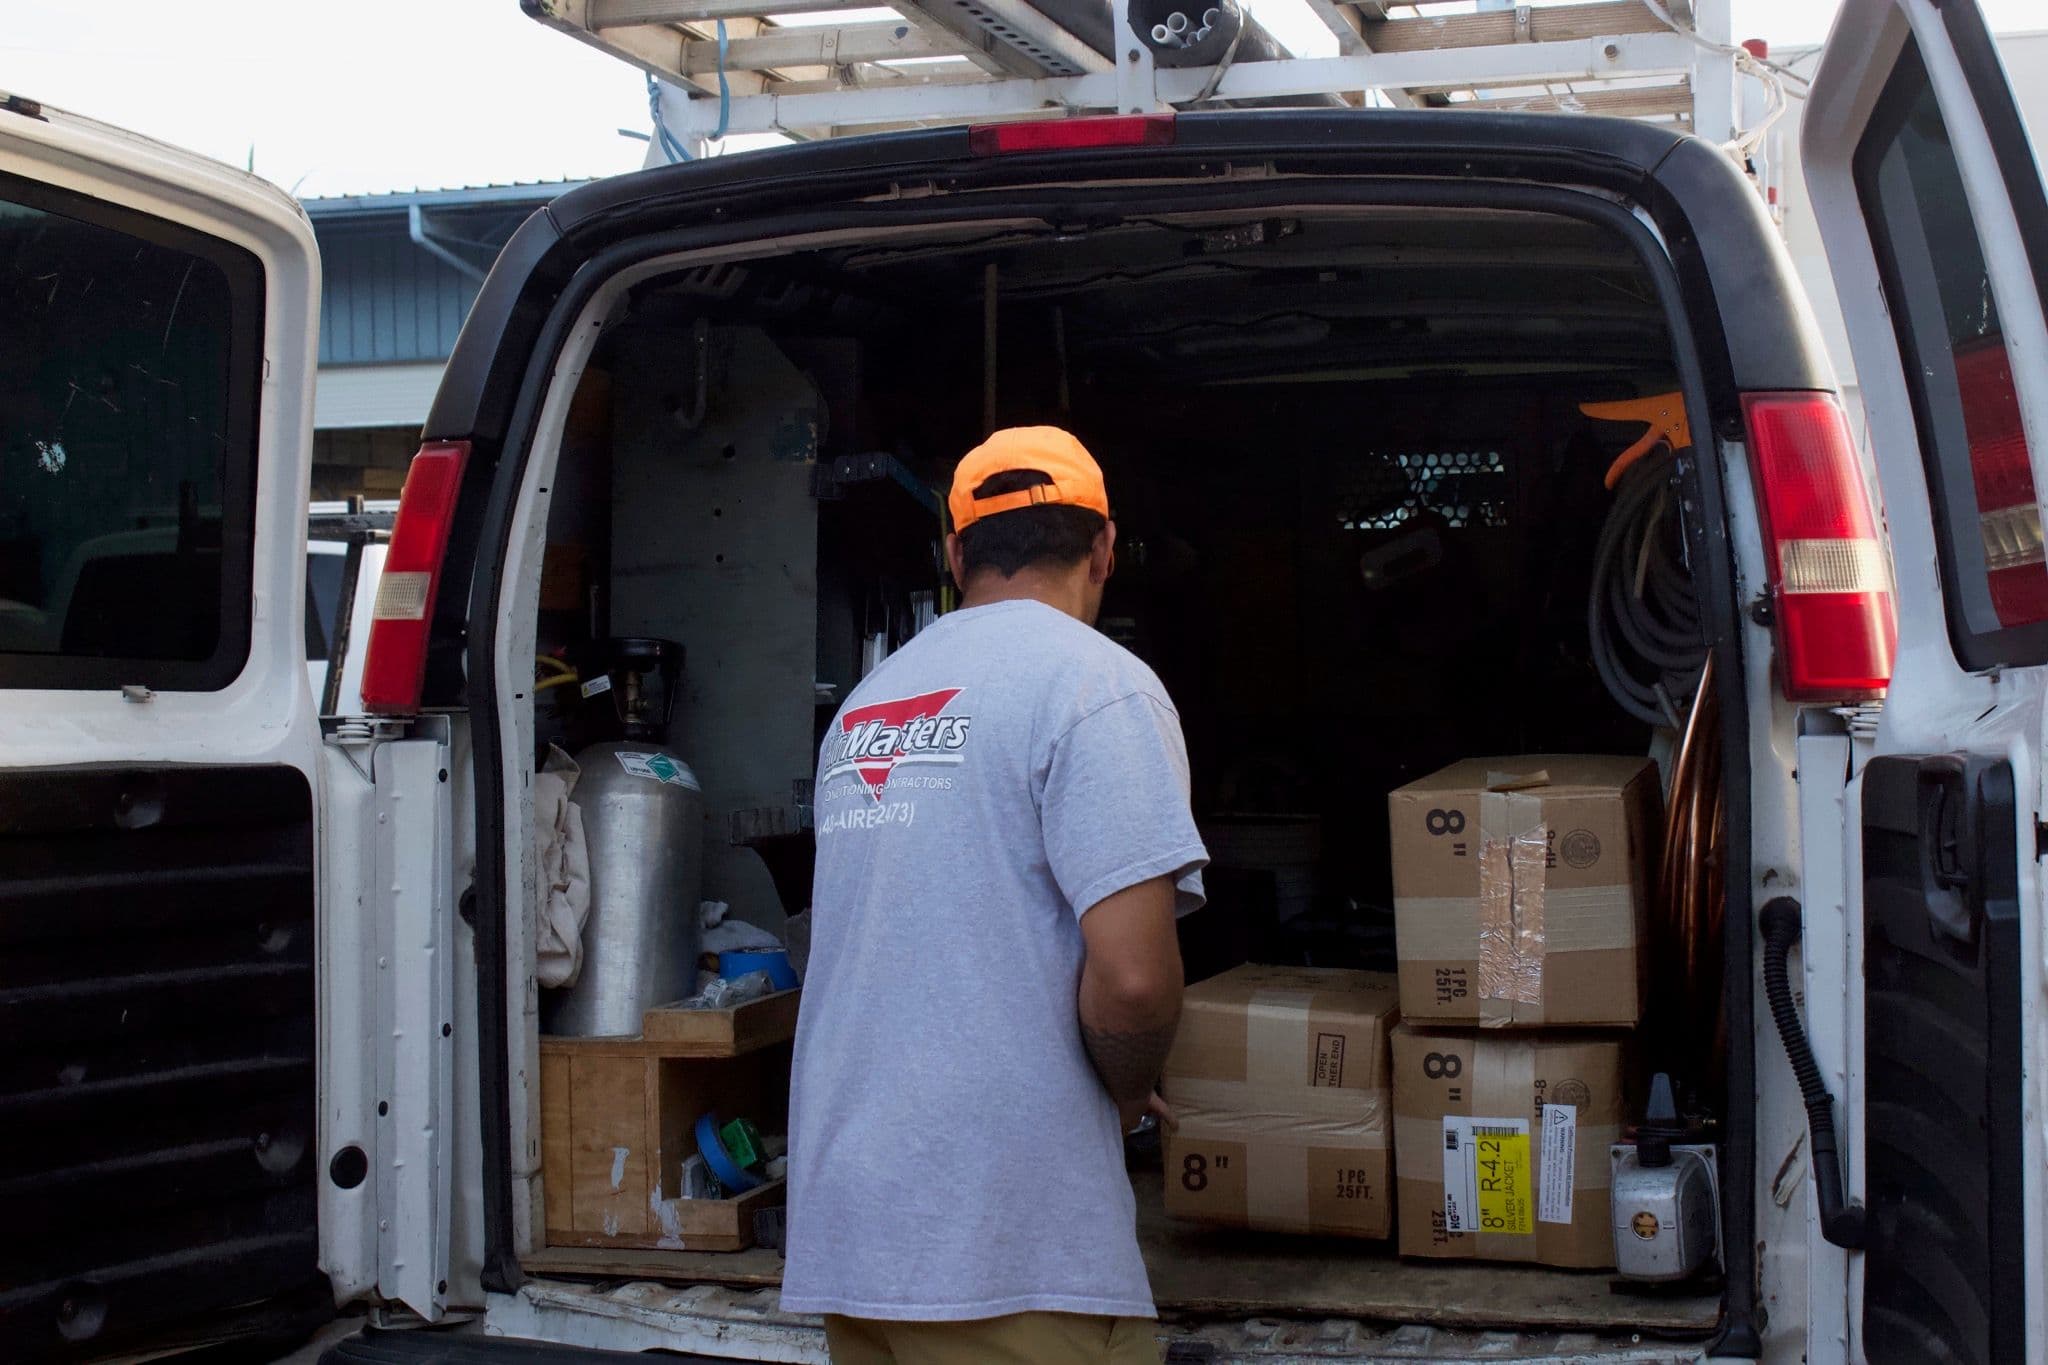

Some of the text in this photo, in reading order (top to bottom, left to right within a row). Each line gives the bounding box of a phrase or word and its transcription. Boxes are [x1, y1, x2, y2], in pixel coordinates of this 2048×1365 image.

[1453, 979, 1467, 998] PC
[1318, 1052, 1328, 1079] OPEN
[1328, 1039, 1340, 1087] THER END
[1347, 1169, 1366, 1184] PC
[1479, 1140, 1505, 1229] 8" R-4.2
[1503, 1159, 1517, 1231] SILVER JACKET
